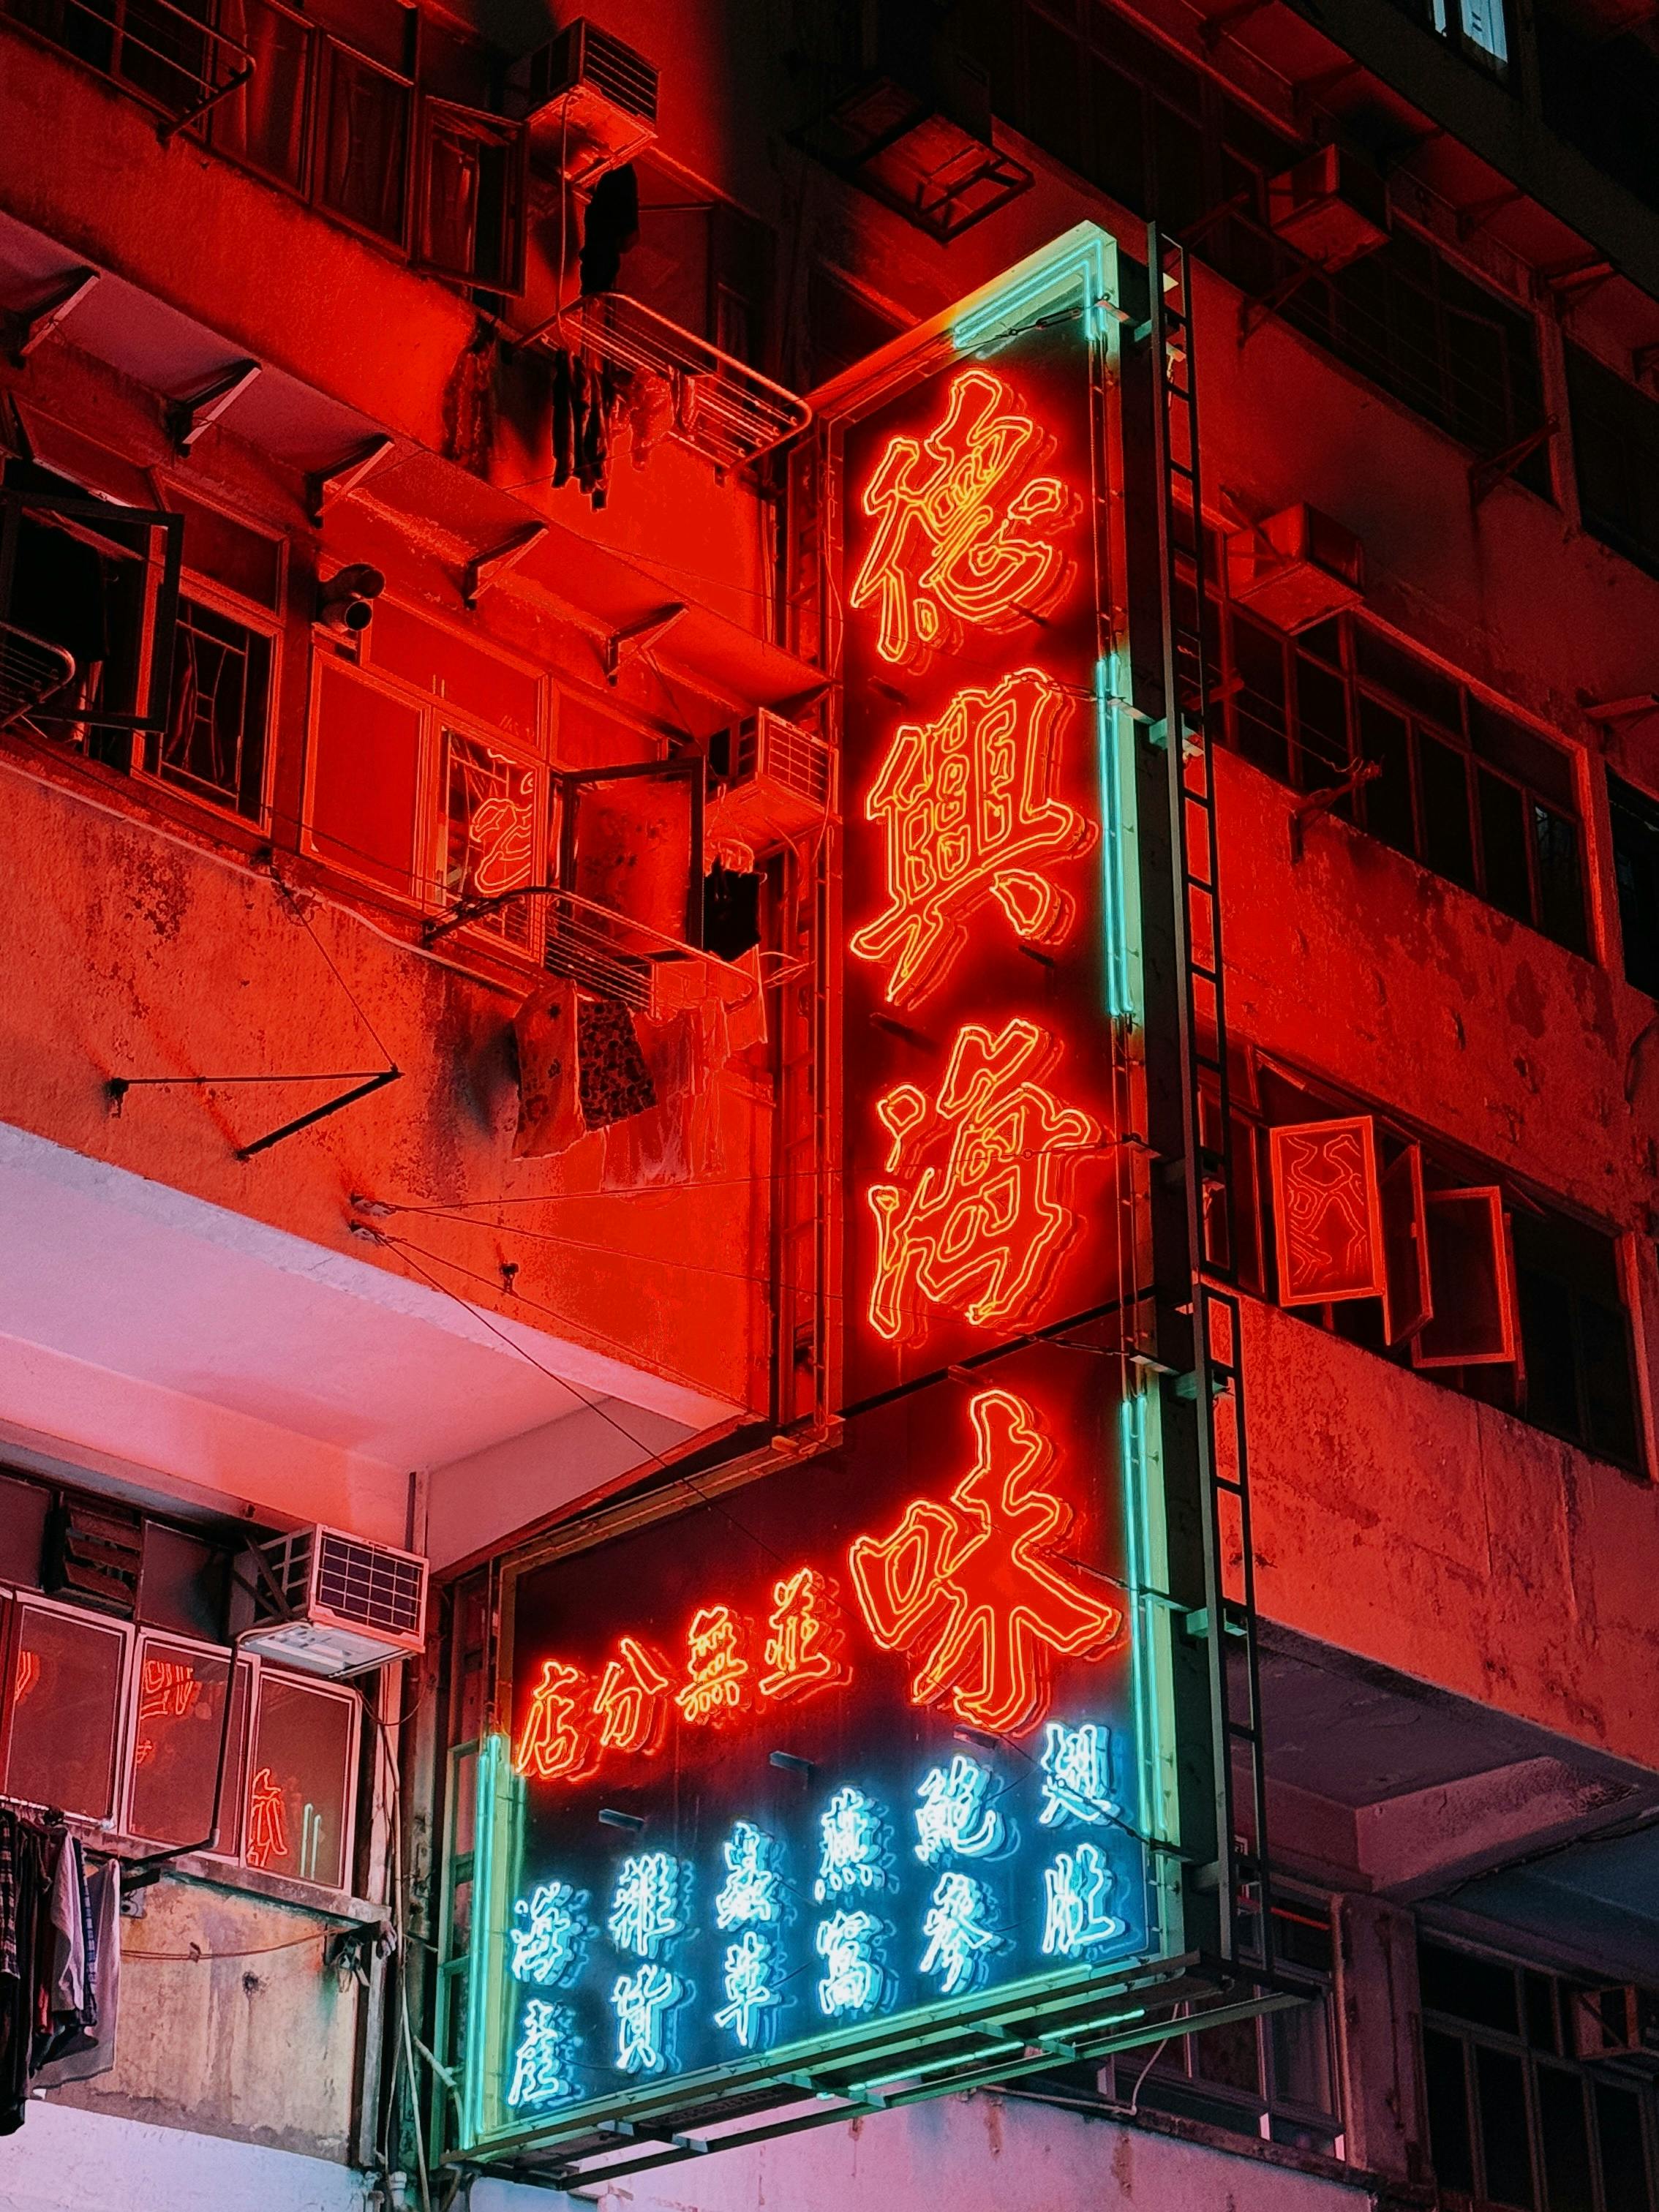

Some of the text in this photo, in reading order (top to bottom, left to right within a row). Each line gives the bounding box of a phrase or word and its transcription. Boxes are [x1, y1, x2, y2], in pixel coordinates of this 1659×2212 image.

[850, 368, 1121, 1729] 德興海味
[609, 1854, 676, 2069] 雜貨
[815, 1788, 873, 2014] 燕窩
[914, 1756, 996, 1993] 鮑參
[508, 1883, 571, 2104] 海產
